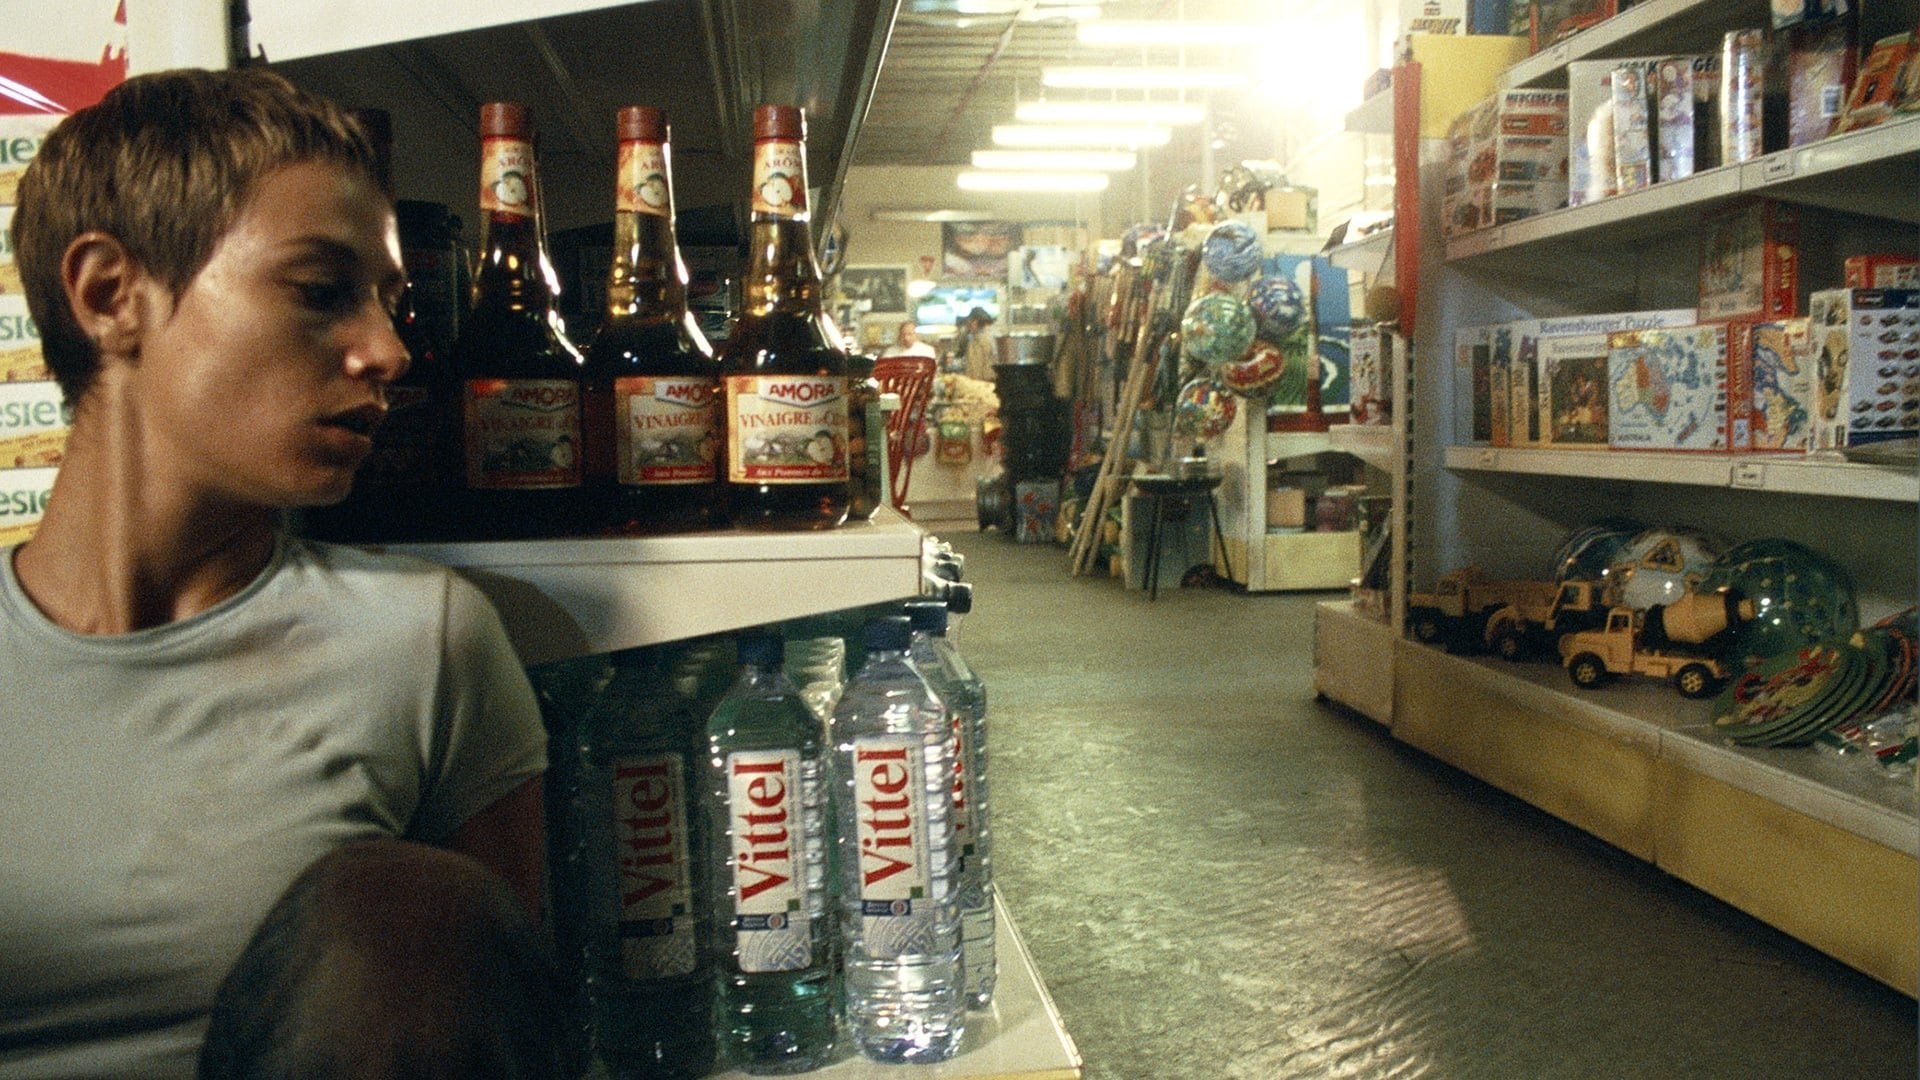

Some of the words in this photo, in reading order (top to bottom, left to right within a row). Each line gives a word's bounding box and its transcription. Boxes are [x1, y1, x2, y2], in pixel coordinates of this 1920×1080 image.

[1540, 318, 1621, 334] Ravensburger
[1624, 314, 1665, 330] Puzzle
[740, 411, 812, 428] VINAIGRE
[768, 382, 835, 402] AMORA
[615, 762, 675, 907] Vittel
[734, 759, 790, 902] Vittel
[857, 747, 913, 887] Vittel
